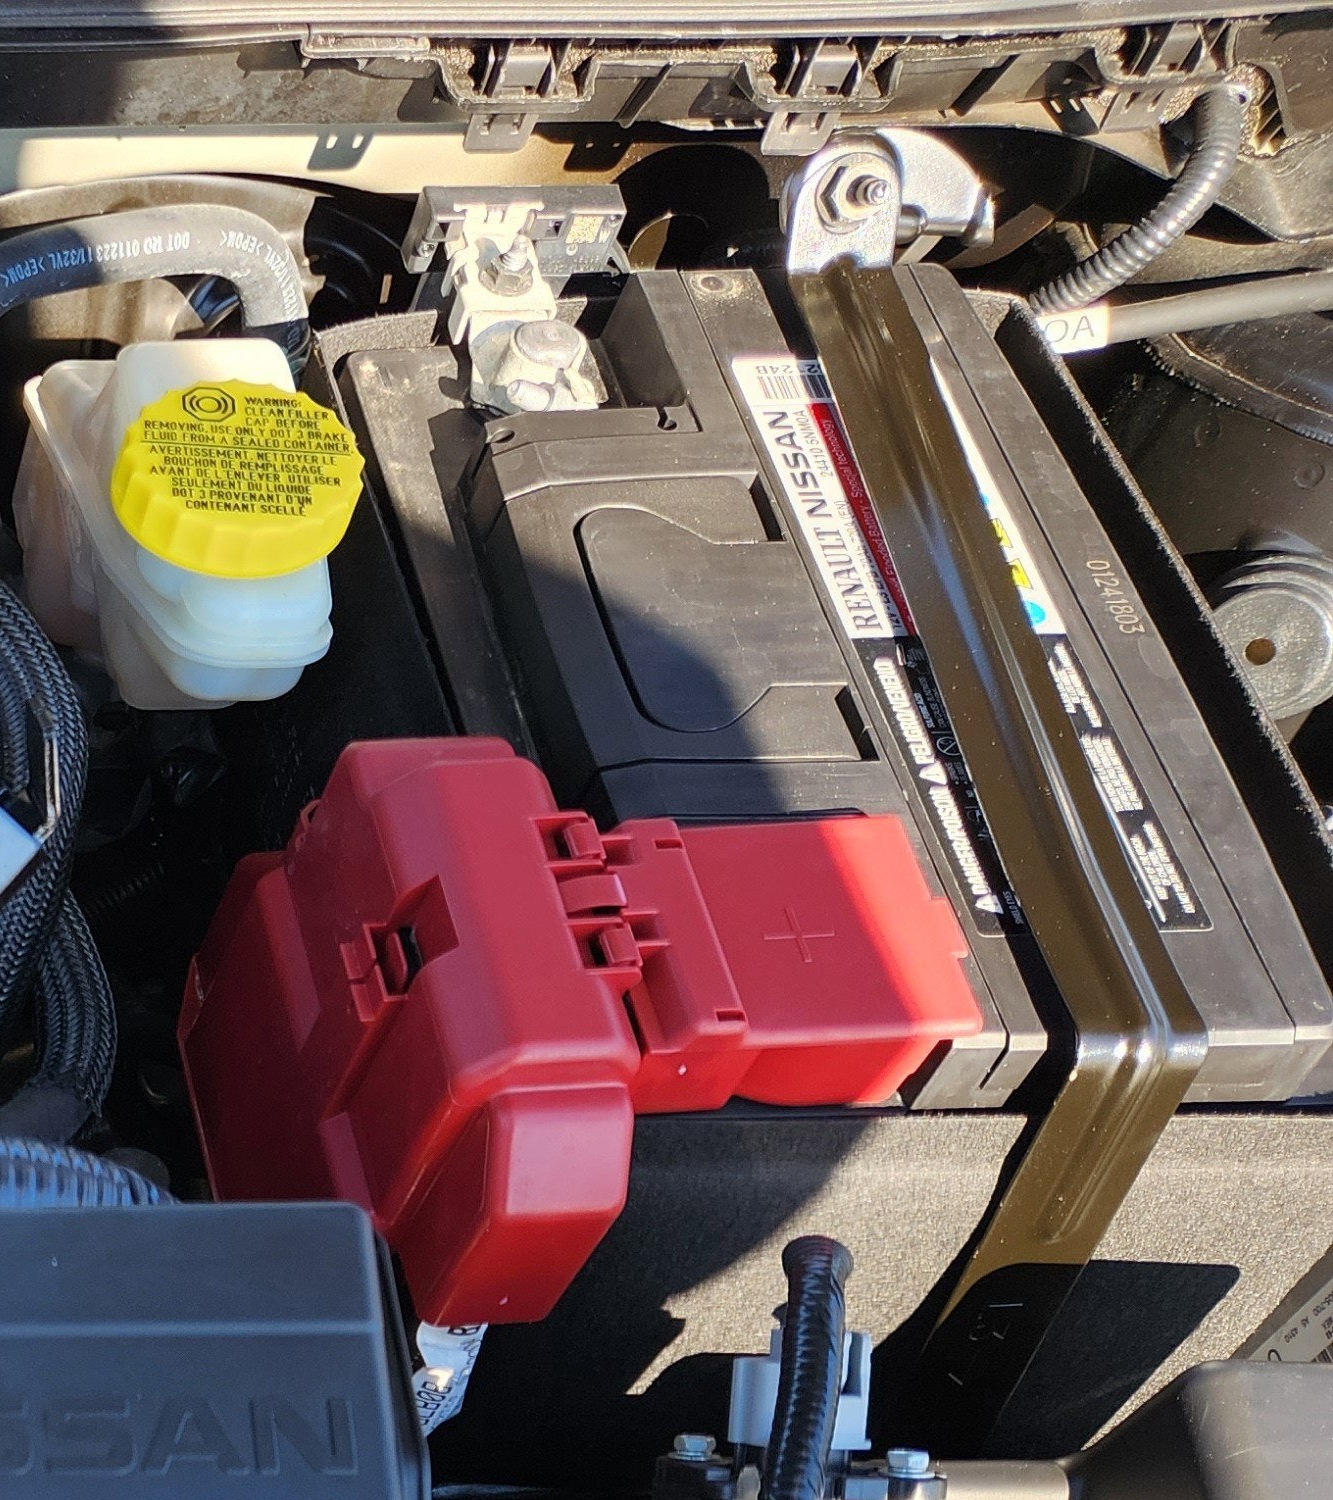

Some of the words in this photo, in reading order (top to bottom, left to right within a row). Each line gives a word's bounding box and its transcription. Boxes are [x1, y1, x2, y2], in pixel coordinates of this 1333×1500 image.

[244, 407, 284, 418] CLEAN
[288, 409, 329, 420] FILLER
[211, 424, 232, 435] USE
[236, 426, 265, 437] ONLY
[270, 428, 293, 439] DOT
[307, 431, 348, 443] BRAKE
[245, 417, 269, 428] CAP
[276, 419, 321, 431] BEFORE
[144, 430, 177, 441] FLUID
[183, 433, 216, 444] FROM
[220, 436, 228, 445] A
[233, 437, 280, 449] SEALED
[163, 456, 217, 468] BOUCHON
[223, 459, 234, 469] DE
[239, 461, 323, 476] REMPLISSAGE
[257, 451, 319, 465] NETTOYER
[323, 456, 337, 466] LE
[761, 410, 833, 519] NISSAN
[150, 464, 192, 477] AVANT
[196, 468, 211, 478] DE
[288, 474, 341, 487] UTILISER
[171, 476, 244, 491] SEULEMENT
[248, 481, 262, 491] DU
[266, 482, 312, 495] LIQUIDE
[171, 487, 194, 499] DOT
[209, 490, 282, 504] PROVENANT
[185, 499, 257, 513] CONTENANT
[812, 526, 884, 632] RENAULT
[1086, 560, 1145, 633] 01241803
